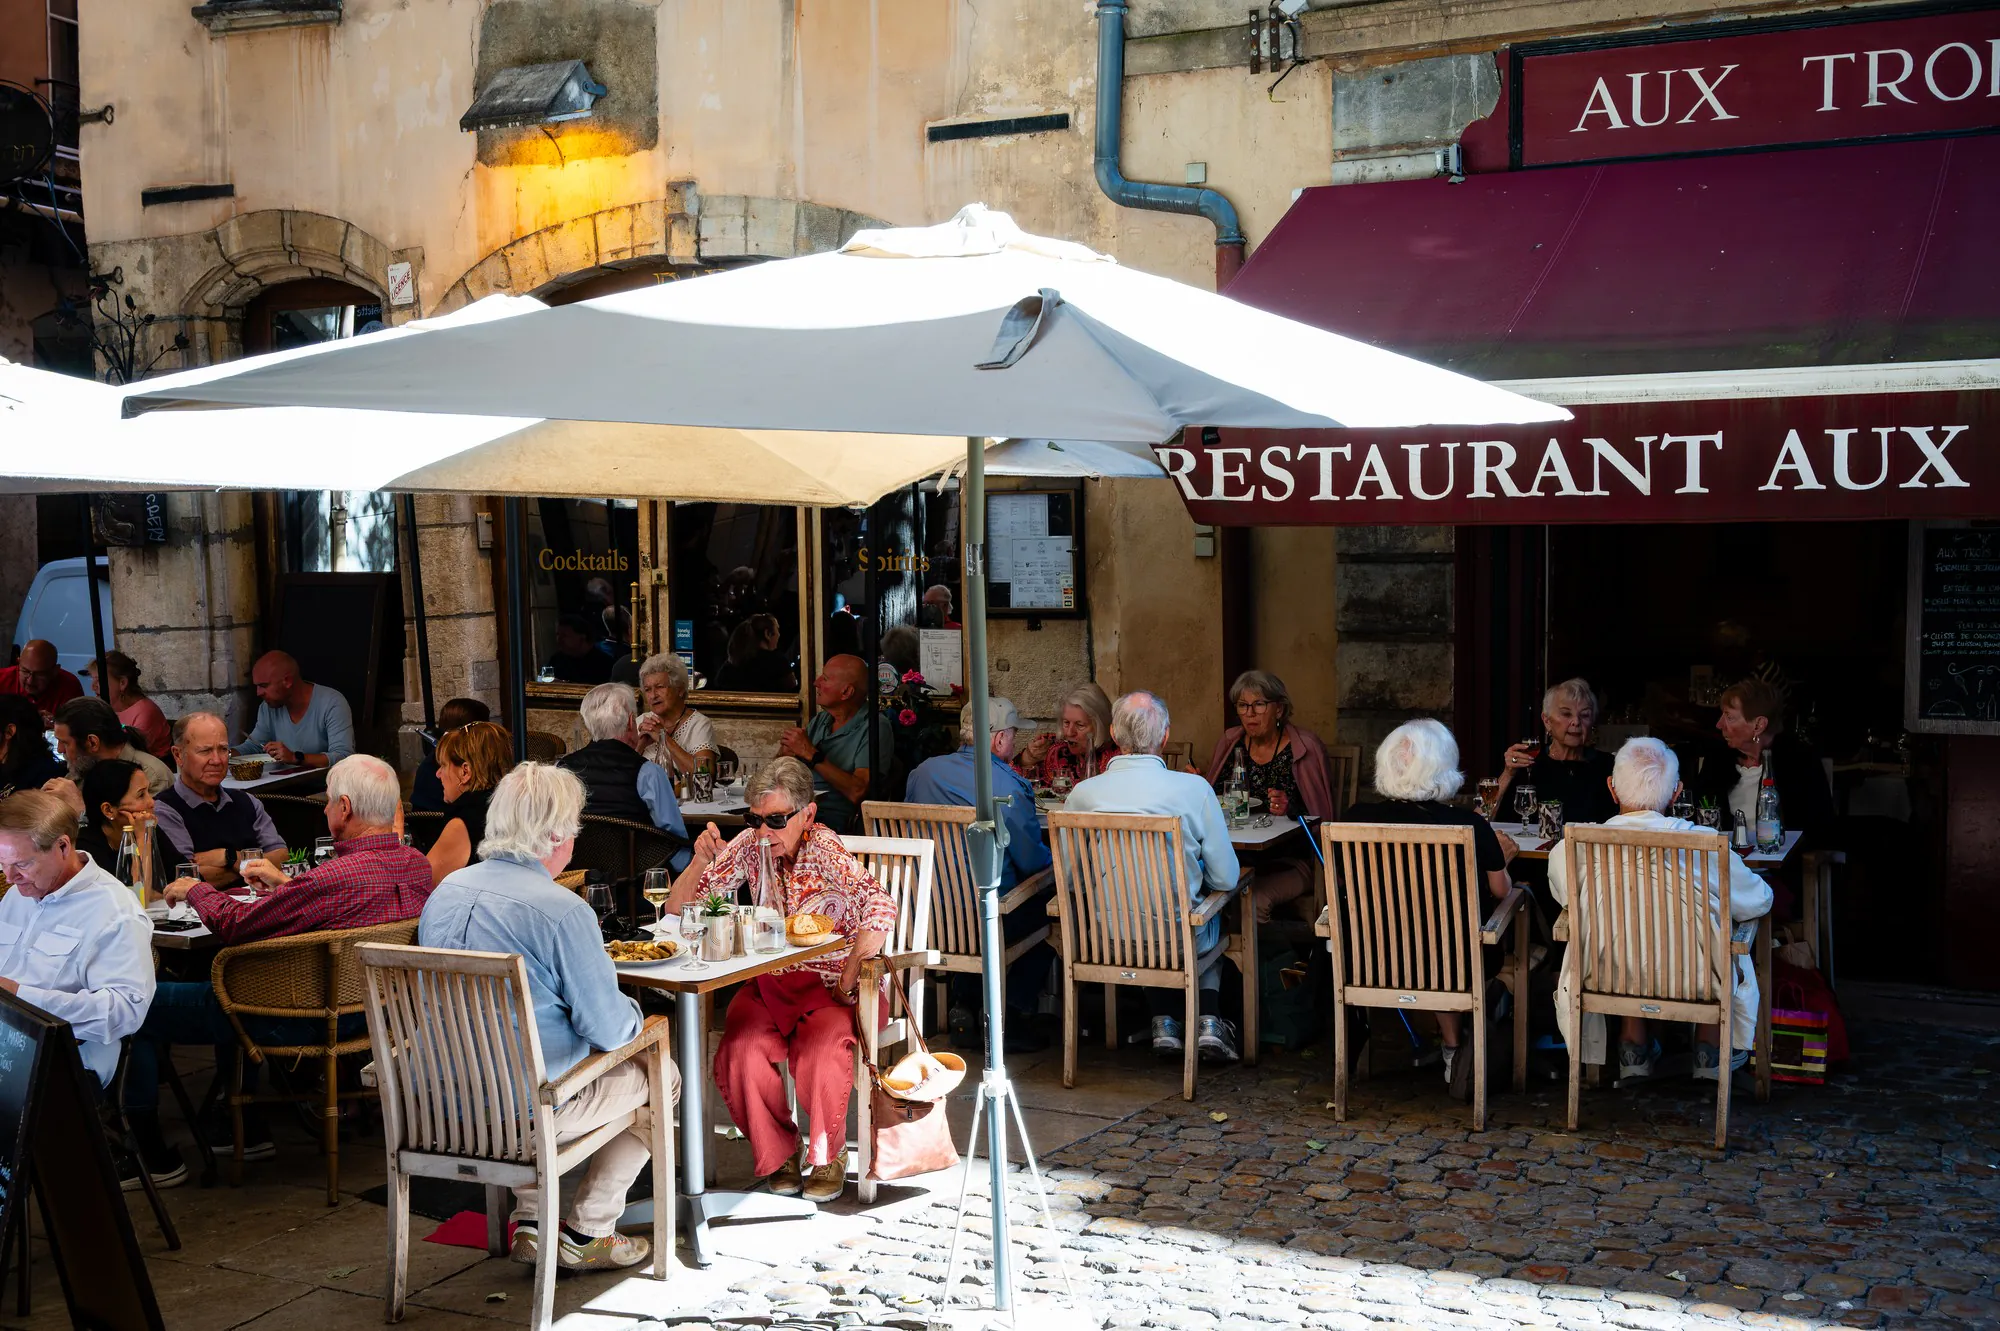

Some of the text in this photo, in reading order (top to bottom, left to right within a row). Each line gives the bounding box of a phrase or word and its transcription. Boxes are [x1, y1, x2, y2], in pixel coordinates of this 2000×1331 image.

[1569, 63, 1741, 133] AUX
[391, 270, 411, 301] LICENCE
[1153, 425, 1971, 503] RESTAURANT AUX
[538, 548, 629, 572] Cocktails
